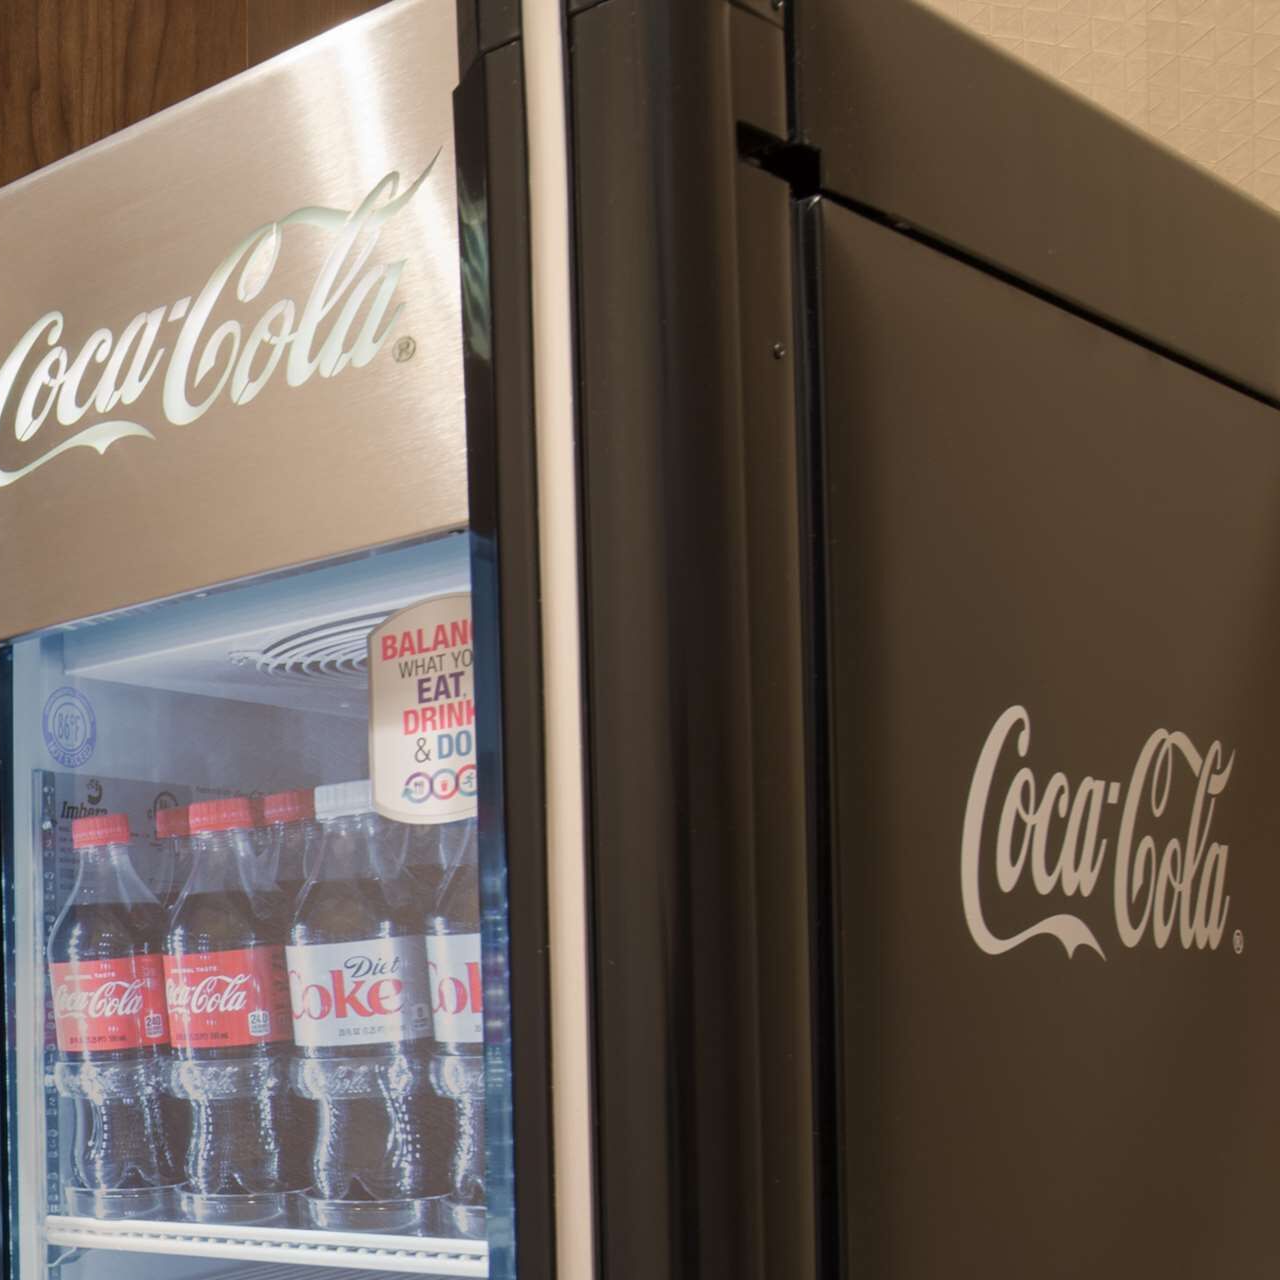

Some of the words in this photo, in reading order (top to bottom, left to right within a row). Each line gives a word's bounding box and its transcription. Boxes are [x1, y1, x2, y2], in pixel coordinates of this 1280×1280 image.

[381, 619, 473, 661] BALAN
[398, 653, 446, 679] WHAT
[417, 671, 467, 704] EAT,
[415, 737, 432, 763] &
[437, 730, 473, 760] DO
[961, 705, 1235, 961] Coca-Cola
[344, 955, 400, 979] Diet
[58, 979, 146, 1018] Coca-Cola
[289, 969, 404, 1020] Coke
